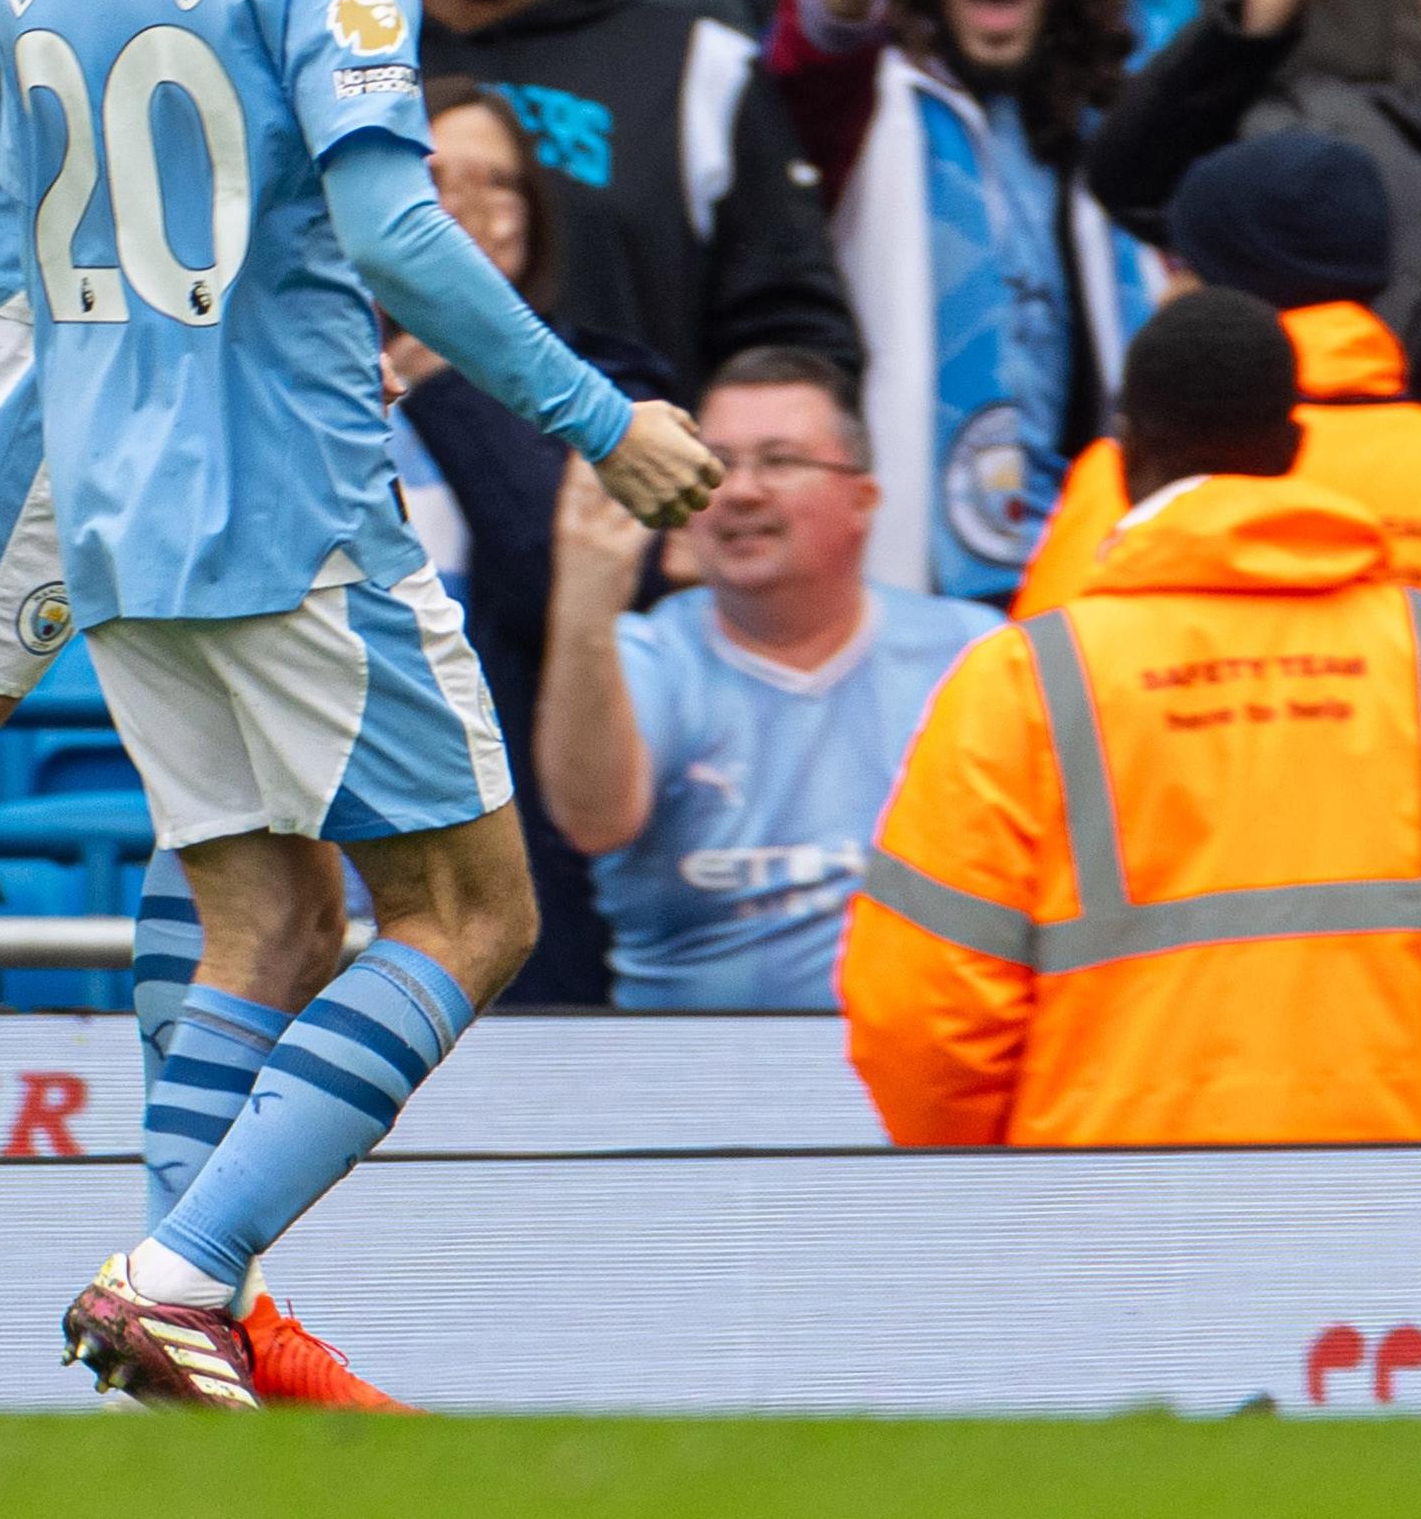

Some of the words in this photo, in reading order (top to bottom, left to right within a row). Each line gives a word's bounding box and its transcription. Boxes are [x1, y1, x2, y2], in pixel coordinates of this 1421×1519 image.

[14, 24, 251, 327] 20
[1141, 657, 1270, 691] SAFETY
[1278, 654, 1367, 677] TEAM
